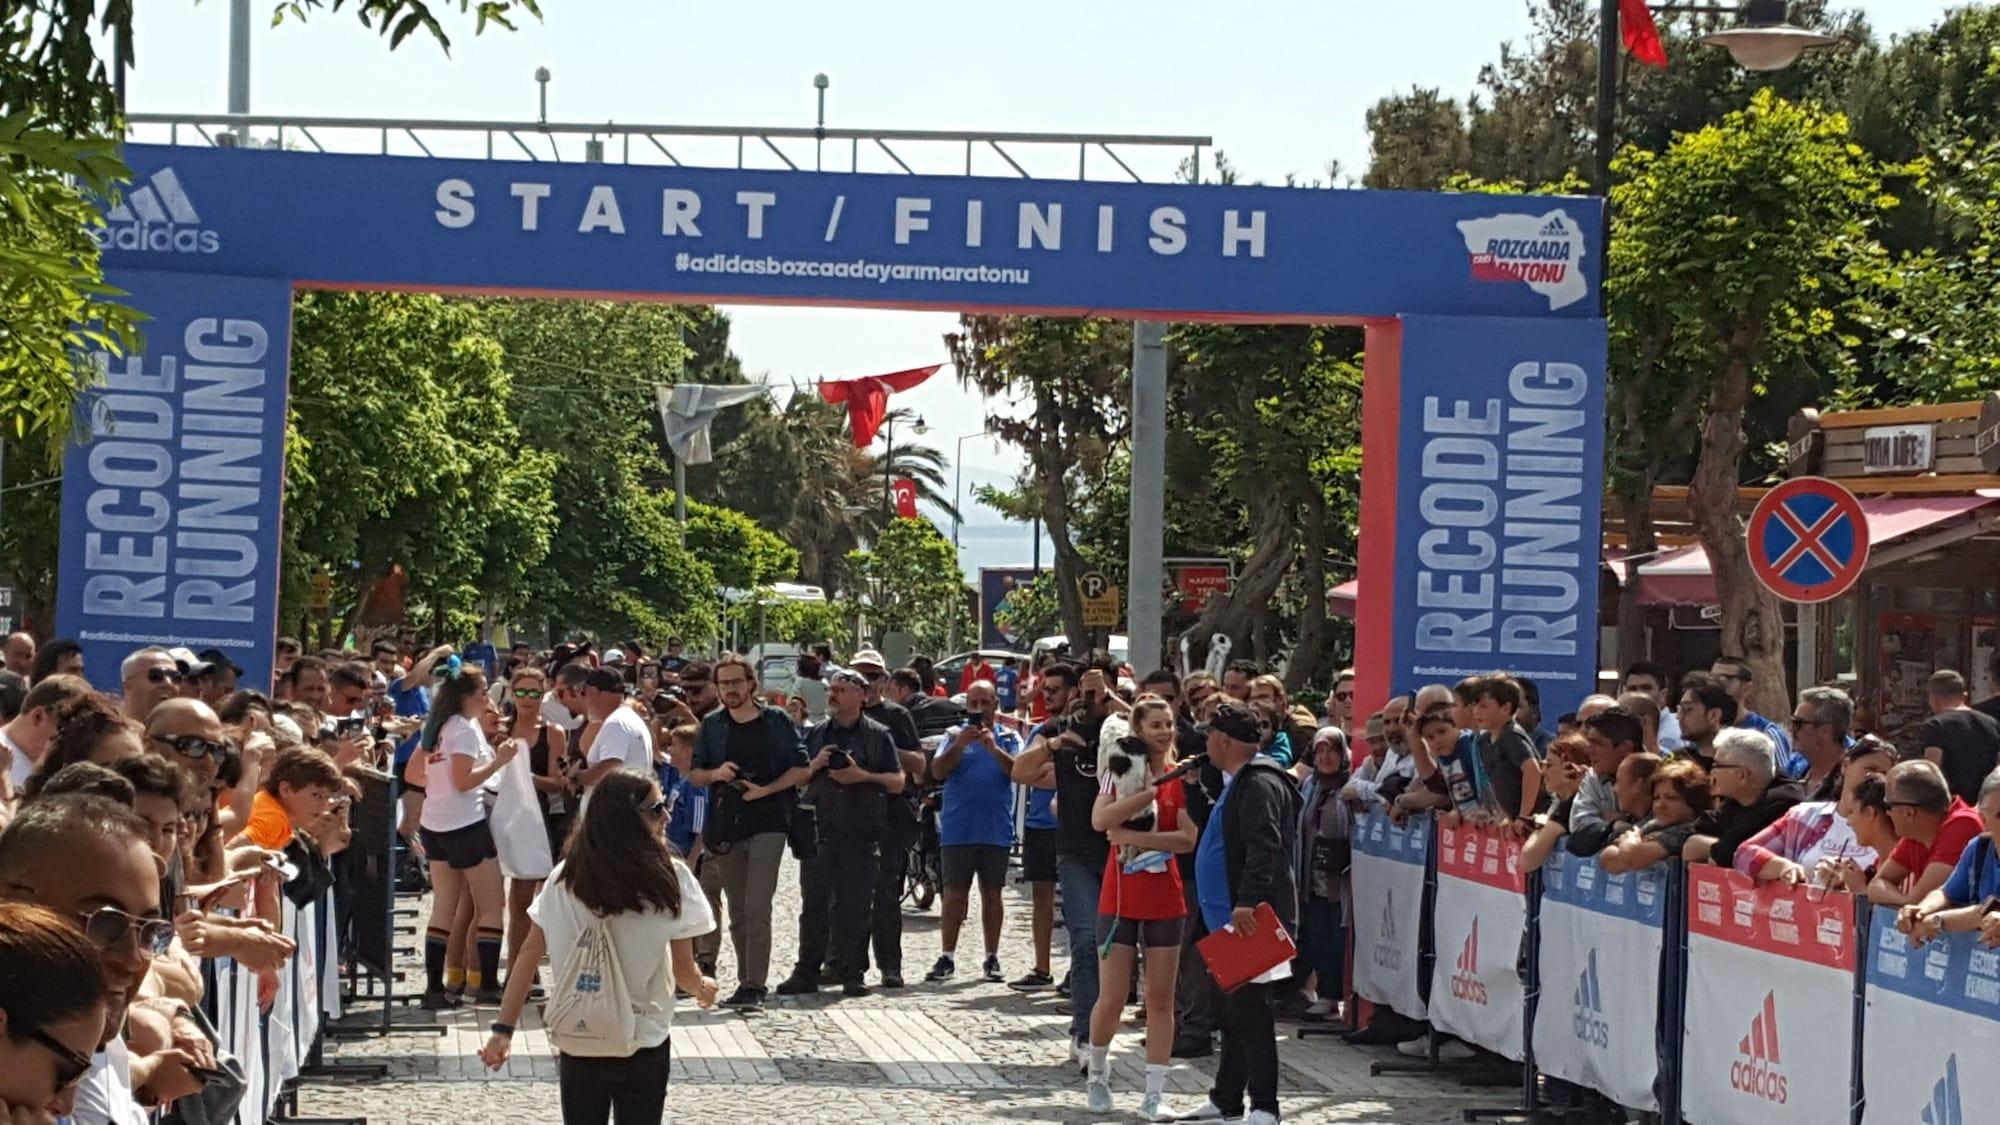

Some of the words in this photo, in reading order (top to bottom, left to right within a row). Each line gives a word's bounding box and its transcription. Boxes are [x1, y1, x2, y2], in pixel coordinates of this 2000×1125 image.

[91, 220, 220, 254] adidas
[435, 178, 775, 240] START
[895, 197, 1267, 258] FINISH
[82, 350, 177, 619] RECODE
[173, 316, 269, 623] RUNNING
[1415, 396, 1501, 654] RECODE
[1500, 360, 1589, 658] RUNNING
[1730, 1056, 1788, 1105] adidas
